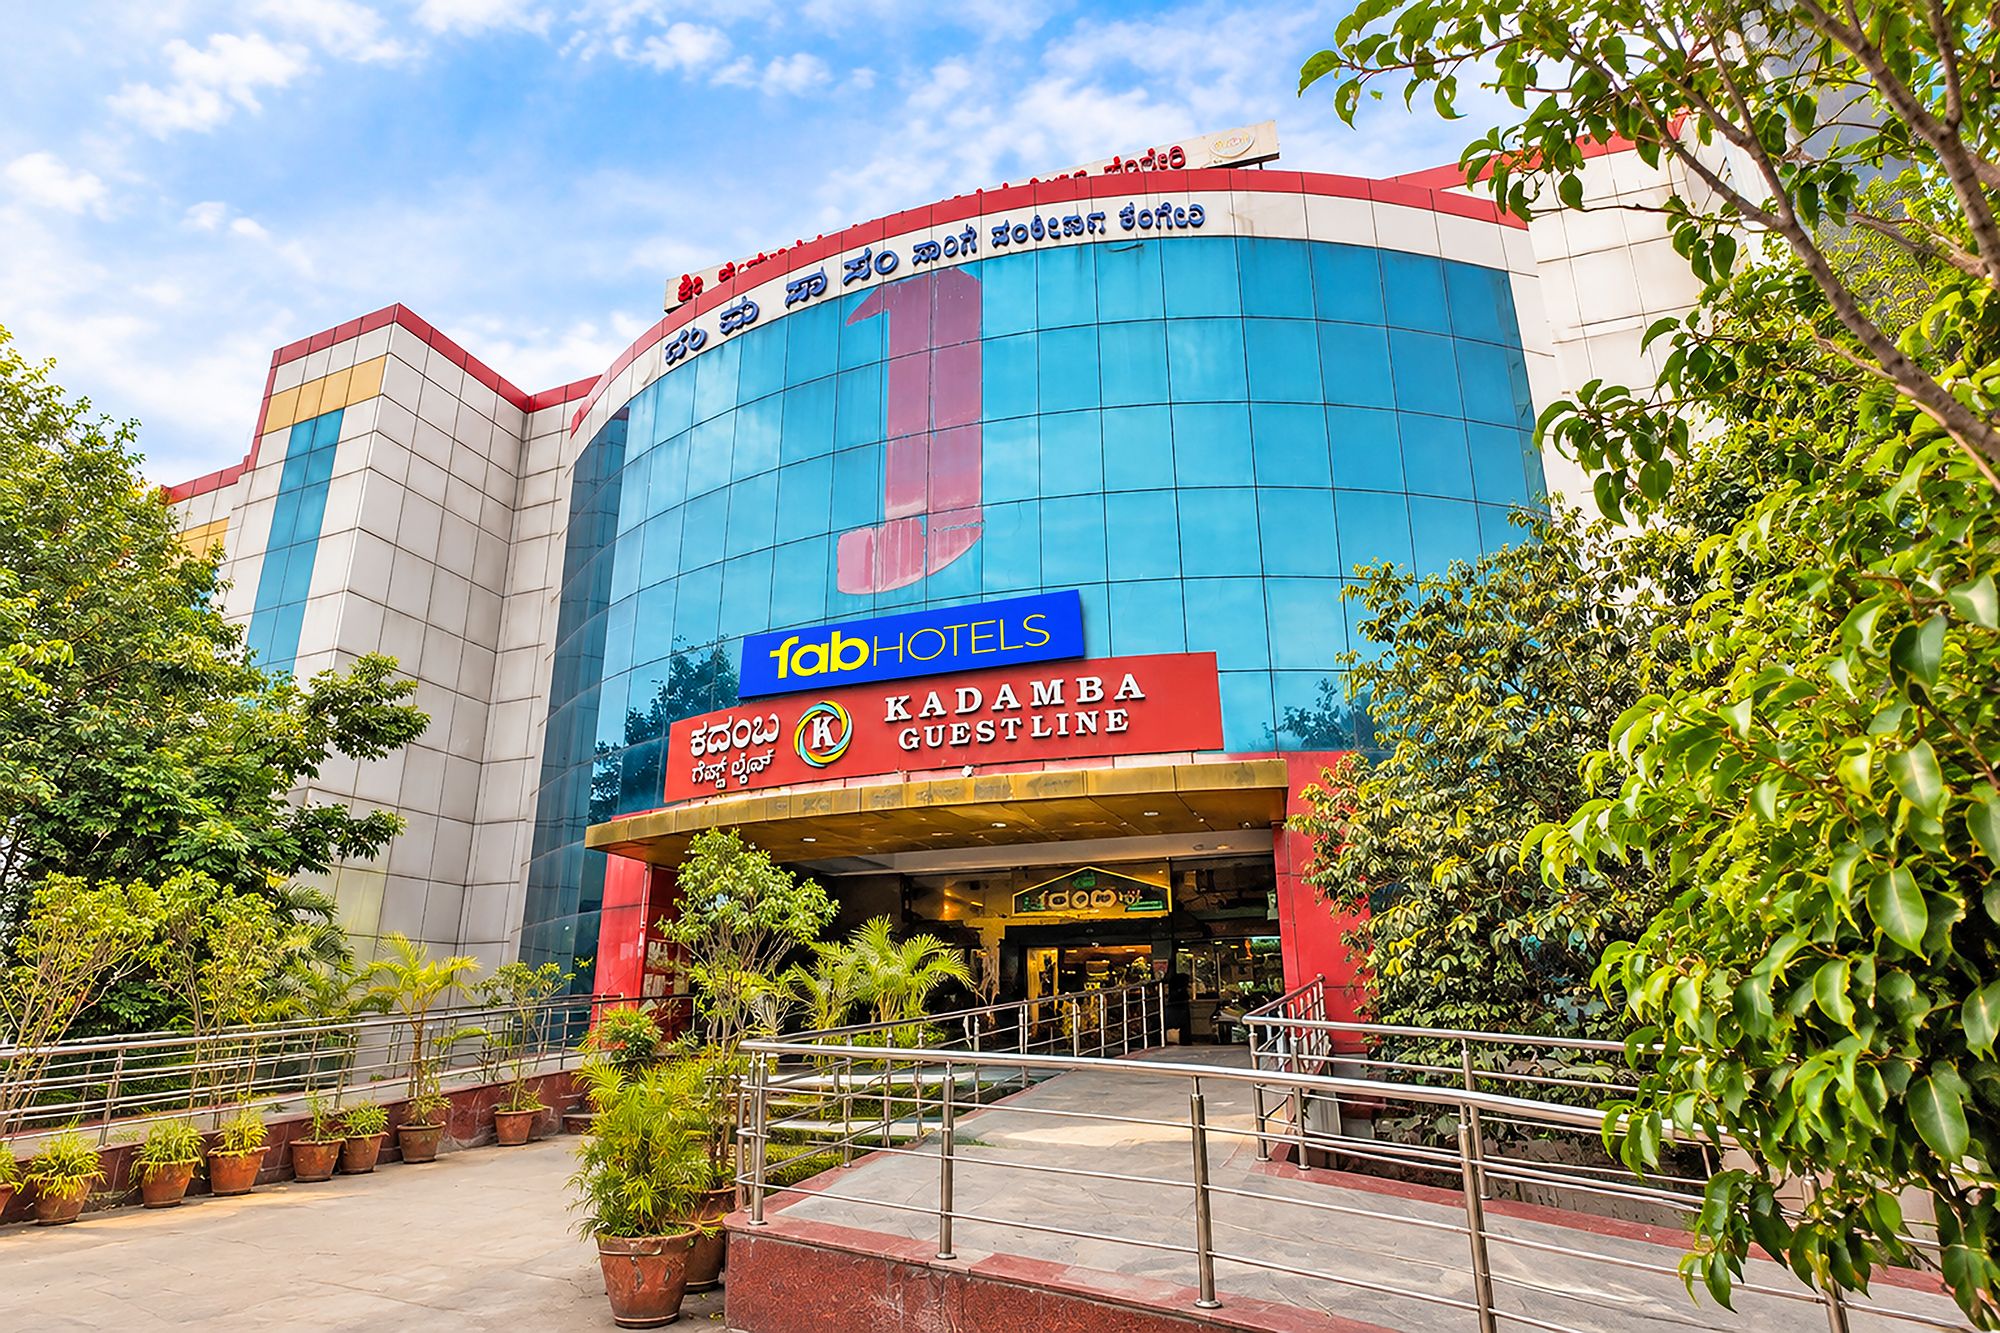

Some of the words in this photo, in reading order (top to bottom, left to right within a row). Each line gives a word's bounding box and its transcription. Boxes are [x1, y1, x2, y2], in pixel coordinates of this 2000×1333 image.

[884, 673, 1146, 722] KADAMBA
[690, 713, 781, 757] ಕದಂಬ
[811, 715, 838, 750] K
